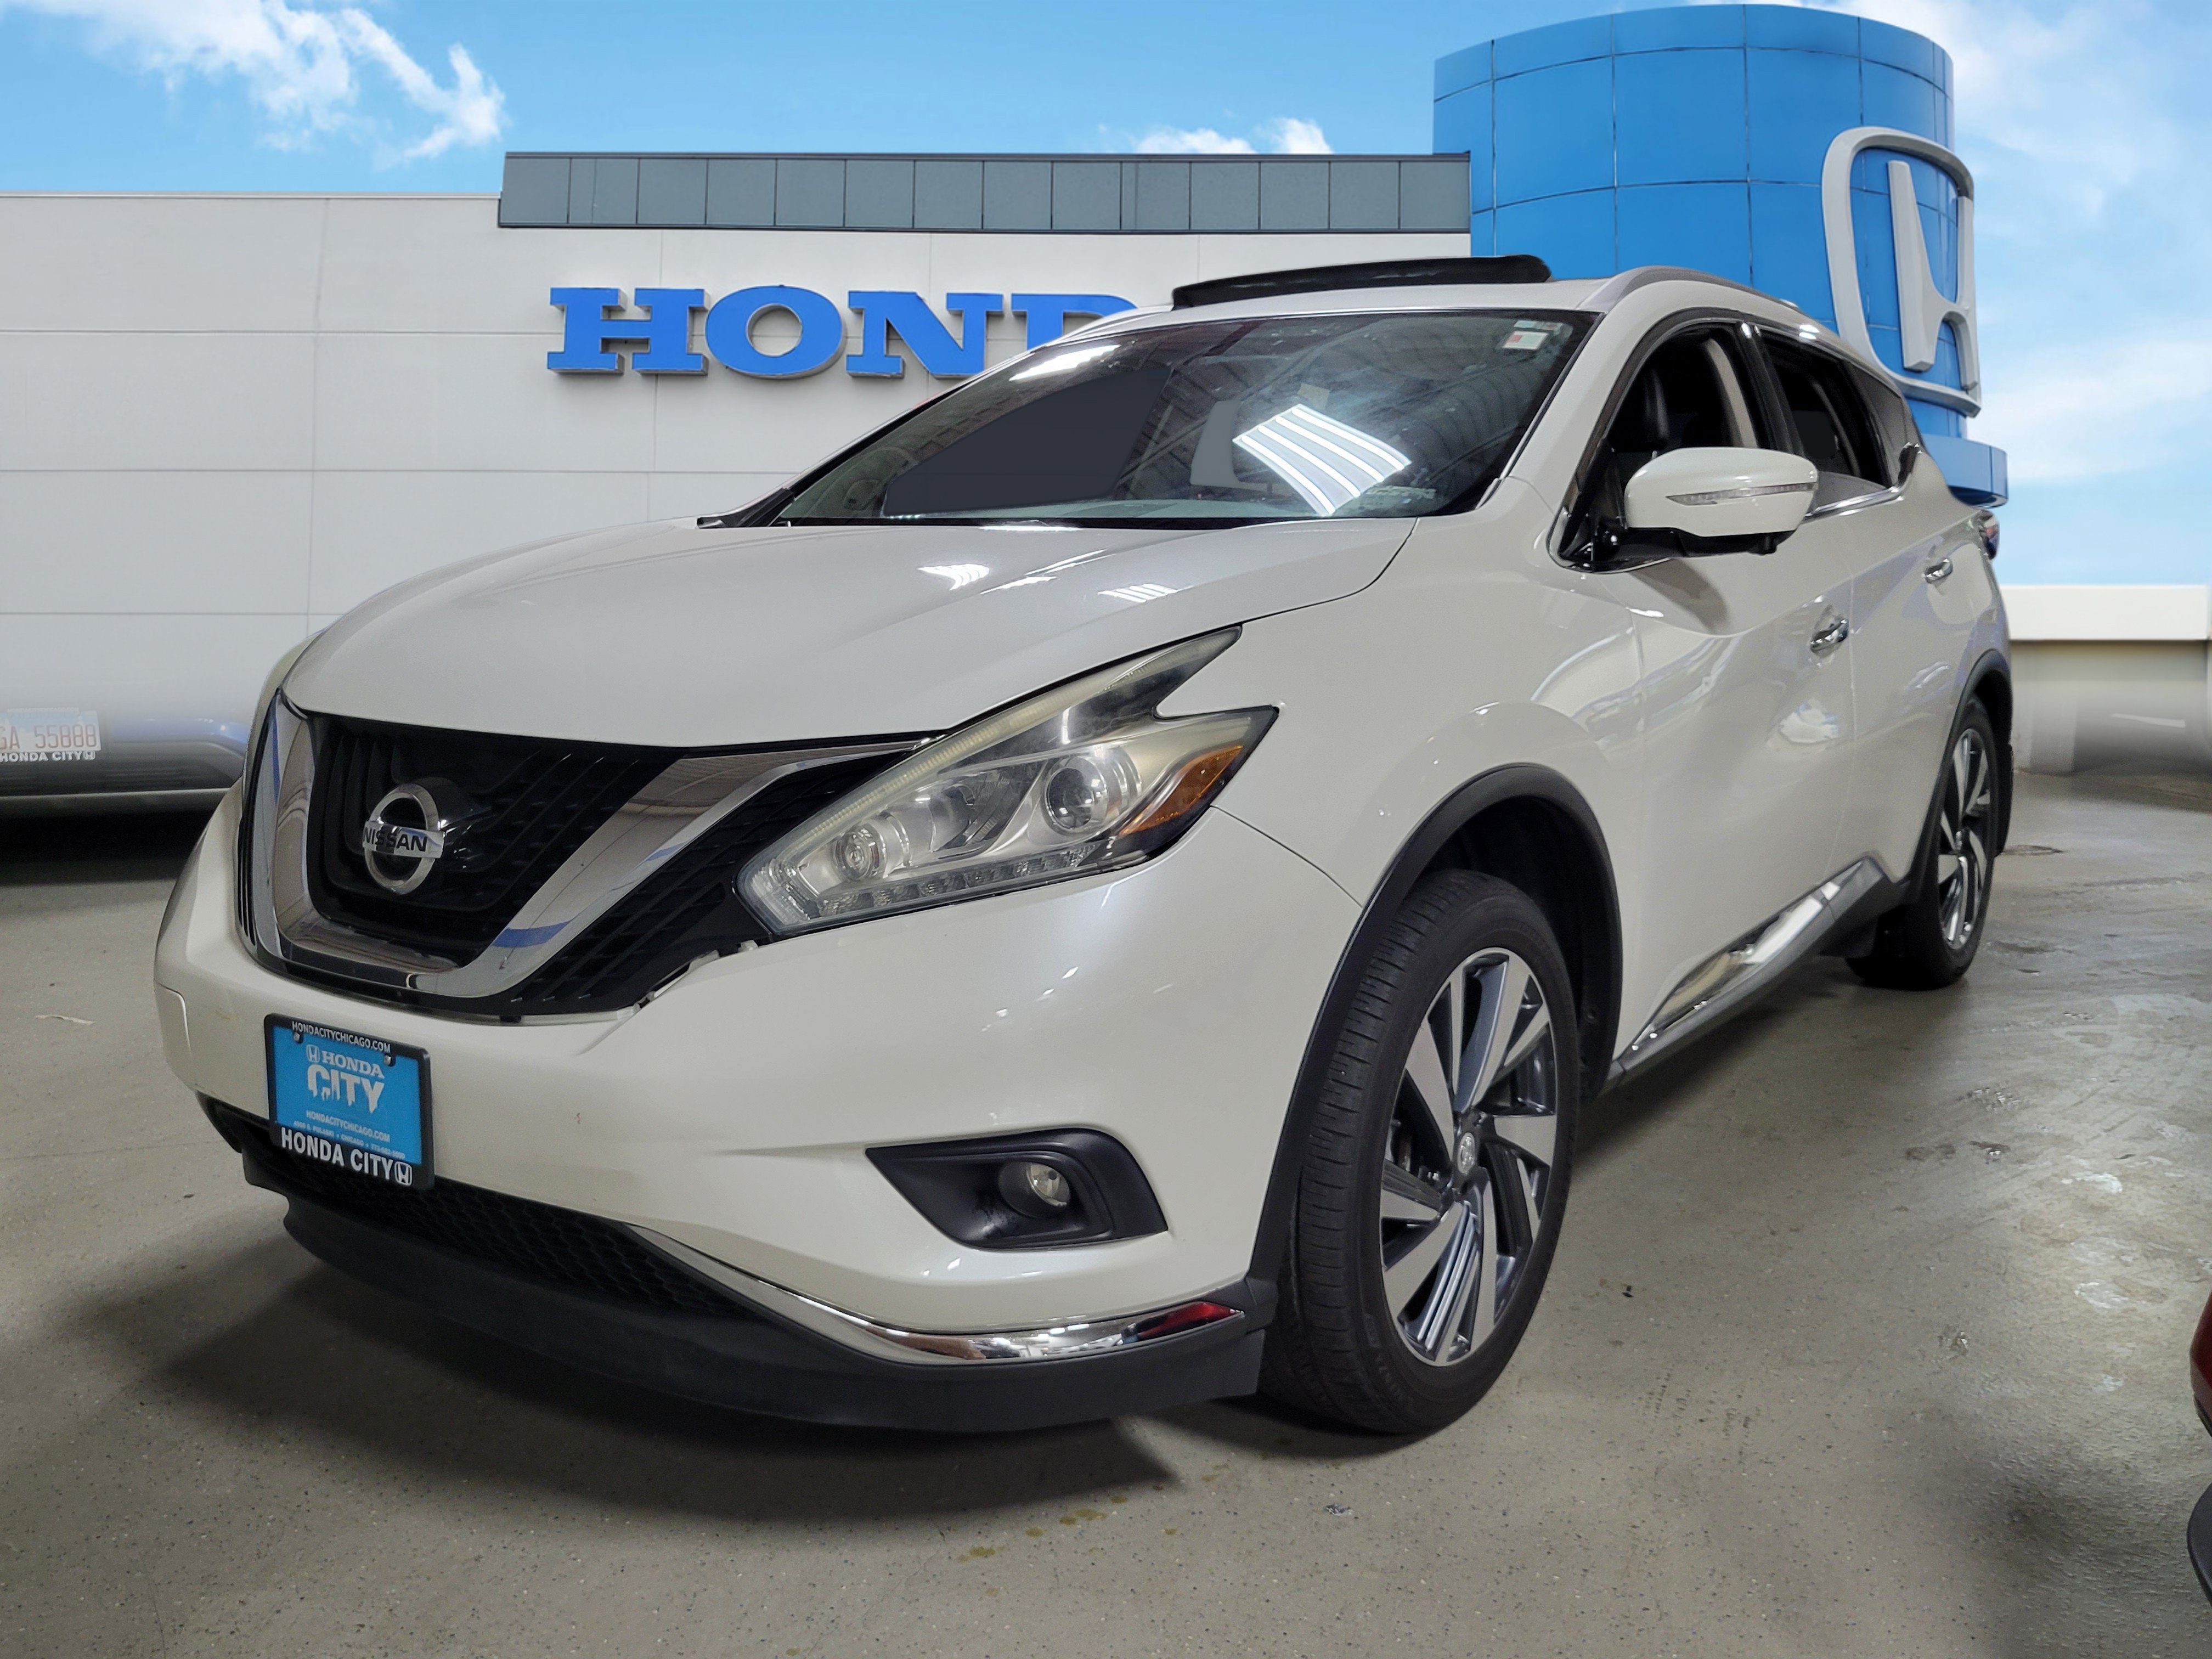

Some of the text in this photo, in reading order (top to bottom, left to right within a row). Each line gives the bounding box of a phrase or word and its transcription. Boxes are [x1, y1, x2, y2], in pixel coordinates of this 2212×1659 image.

[34, 724, 97, 748] 55888
[0, 751, 82, 763] HONDA CITY
[363, 827, 428, 853] NISSAN
[292, 1020, 391, 1053] HONDACITYCHICAGO.COM
[322, 1049, 385, 1079] HONDA
[307, 1064, 385, 1114] CITY
[306, 1110, 390, 1143] HONDACITYCHICAGO.COM
[281, 1127, 345, 1166] HONDA
[351, 1149, 394, 1180] CITY
